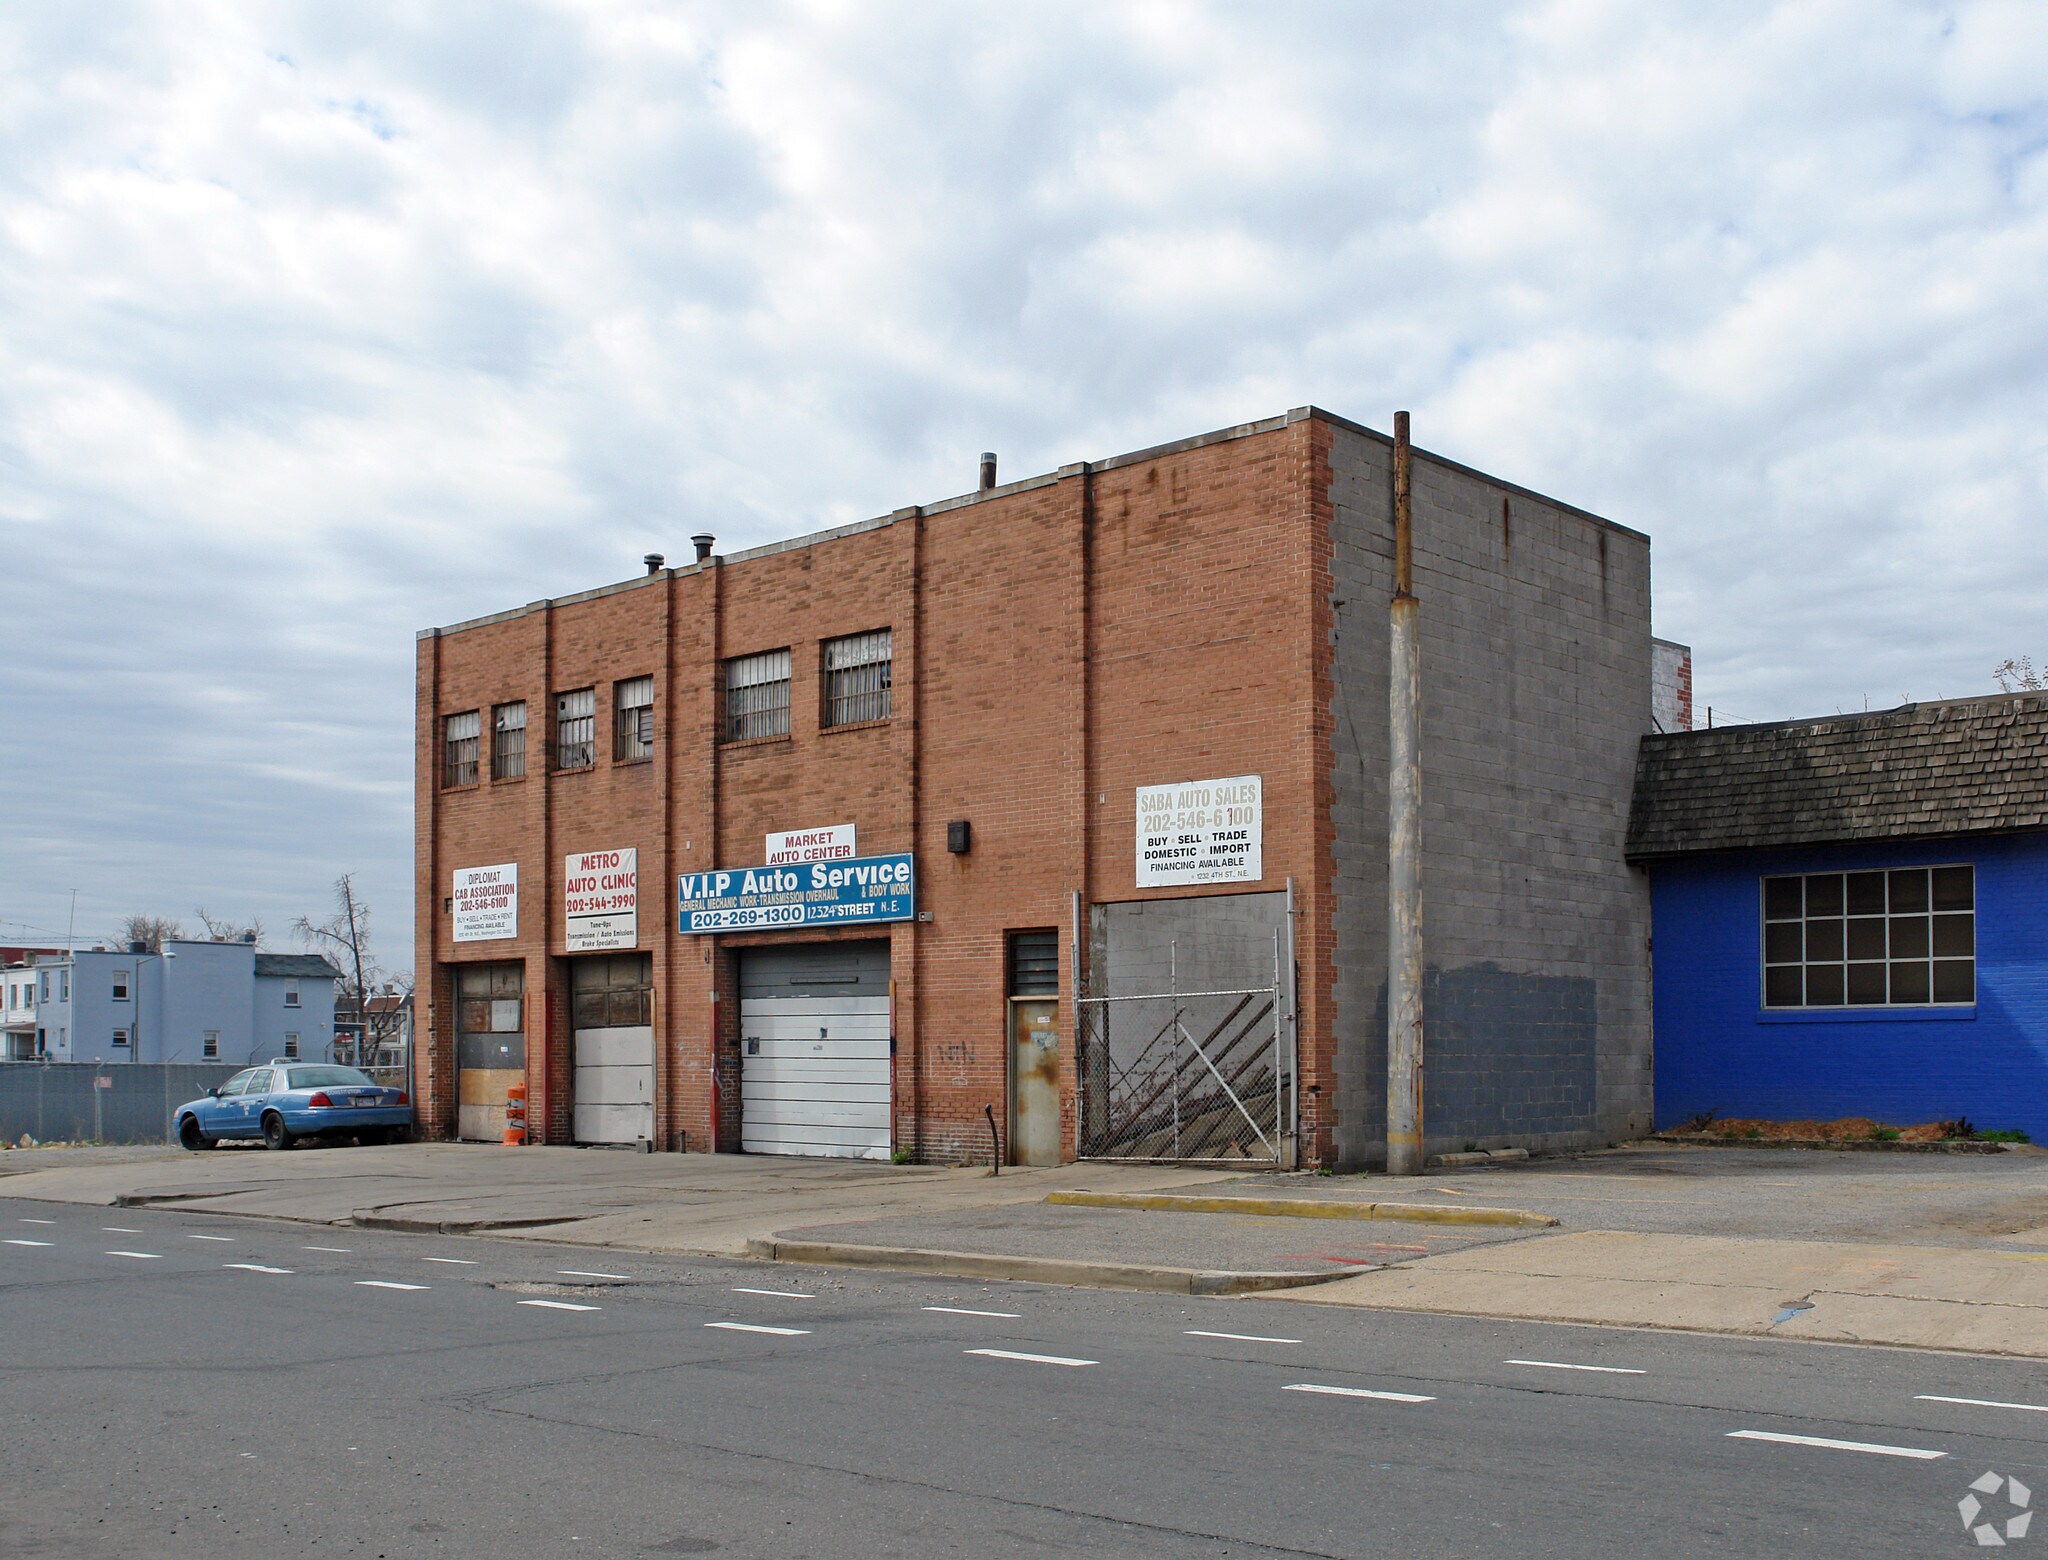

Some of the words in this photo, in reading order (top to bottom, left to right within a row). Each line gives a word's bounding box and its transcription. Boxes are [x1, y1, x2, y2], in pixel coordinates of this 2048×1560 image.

[1142, 792, 1172, 812] SABA
[1177, 788, 1210, 809] AUTO
[1215, 784, 1256, 806] SALES
[786, 832, 834, 848] MARKET
[1148, 837, 1168, 847] BUY
[1178, 834, 1202, 844] SELL
[1212, 830, 1248, 841] TRADE
[770, 850, 799, 864] AUTO
[804, 845, 850, 860] CENTER
[1144, 847, 1196, 860] DOMESTIC
[1210, 843, 1250, 855] IMPORT
[580, 852, 620, 871] METRO
[1150, 861, 1195, 872] FINANCING
[1199, 857, 1244, 868] AVAILABLE
[469, 871, 500, 884] DIPLOMAT
[567, 876, 596, 894] AUTO
[601, 872, 636, 890] CLINIC
[680, 873, 730, 900] V.I.P
[742, 869, 798, 894] Auto
[811, 862, 910, 888] Service
[455, 889, 468, 900] CAB
[470, 884, 514, 898] ASSOCIATION
[680, 900, 706, 912] GENERAL
[708, 896, 737, 909] MECHANIC
[806, 888, 839, 902] OVERHAUL
[862, 886, 866, 898] &
[869, 884, 888, 897] BODY
[890, 882, 910, 895] WORK
[460, 897, 508, 911] 202-546-6100
[567, 894, 634, 912] 202-544-3990
[501, 912, 512, 920] RENT
[694, 906, 801, 927] 202-269-1300
[838, 902, 875, 916] STREET
[590, 921, 612, 929] Tune-Ups
[568, 932, 595, 940] Transmission
